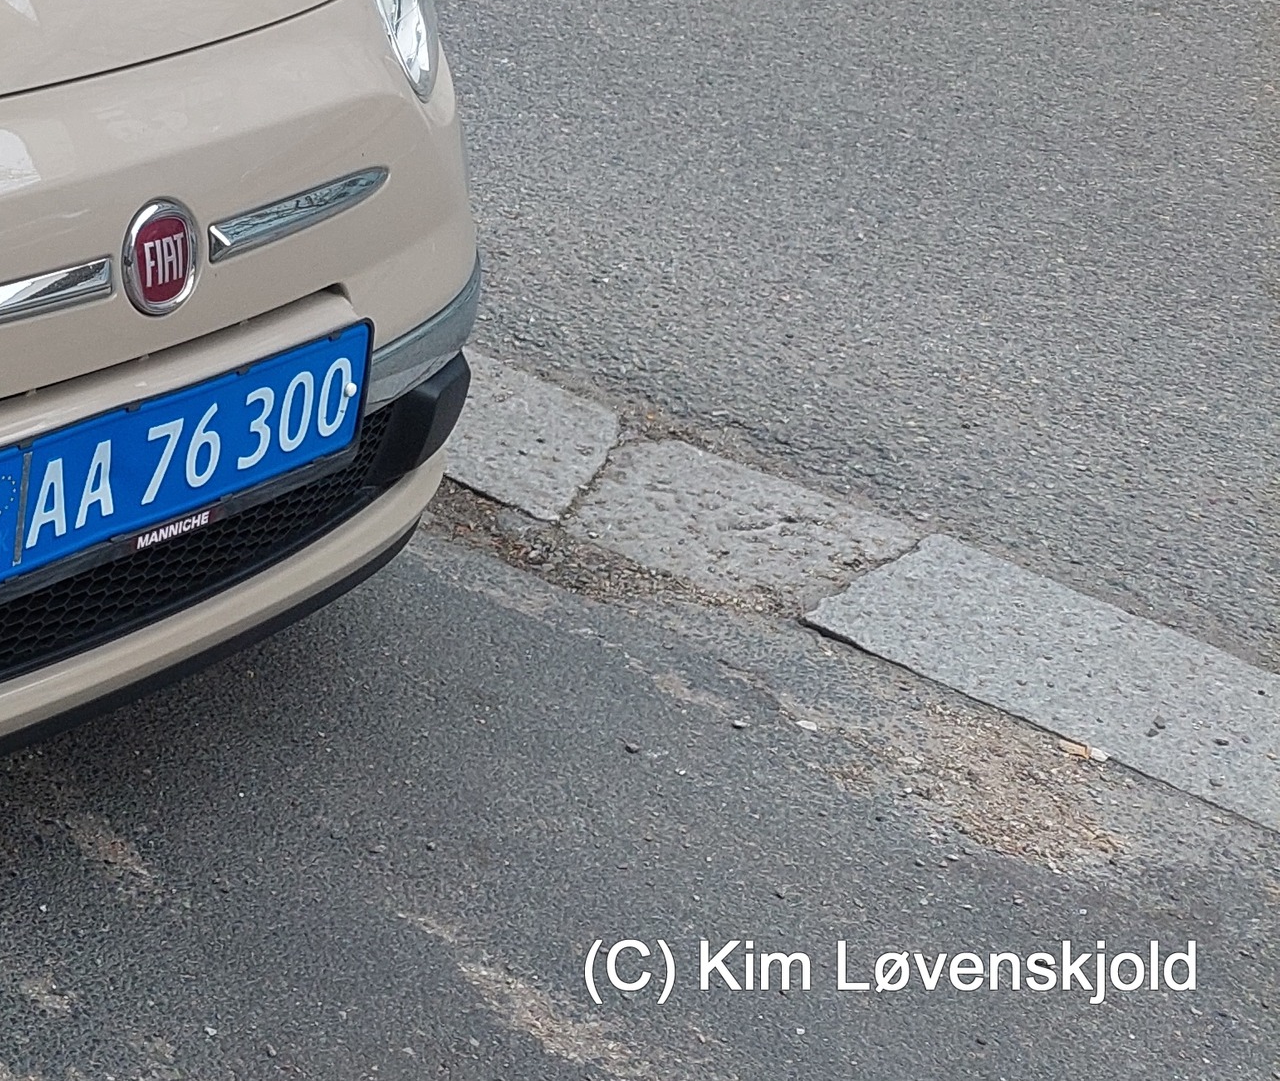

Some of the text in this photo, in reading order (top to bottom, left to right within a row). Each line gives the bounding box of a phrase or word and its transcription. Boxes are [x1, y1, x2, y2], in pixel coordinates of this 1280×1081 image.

[143, 232, 187, 288] FIAT
[25, 357, 354, 549] AA 76 300
[135, 510, 211, 550] MANNICHE
